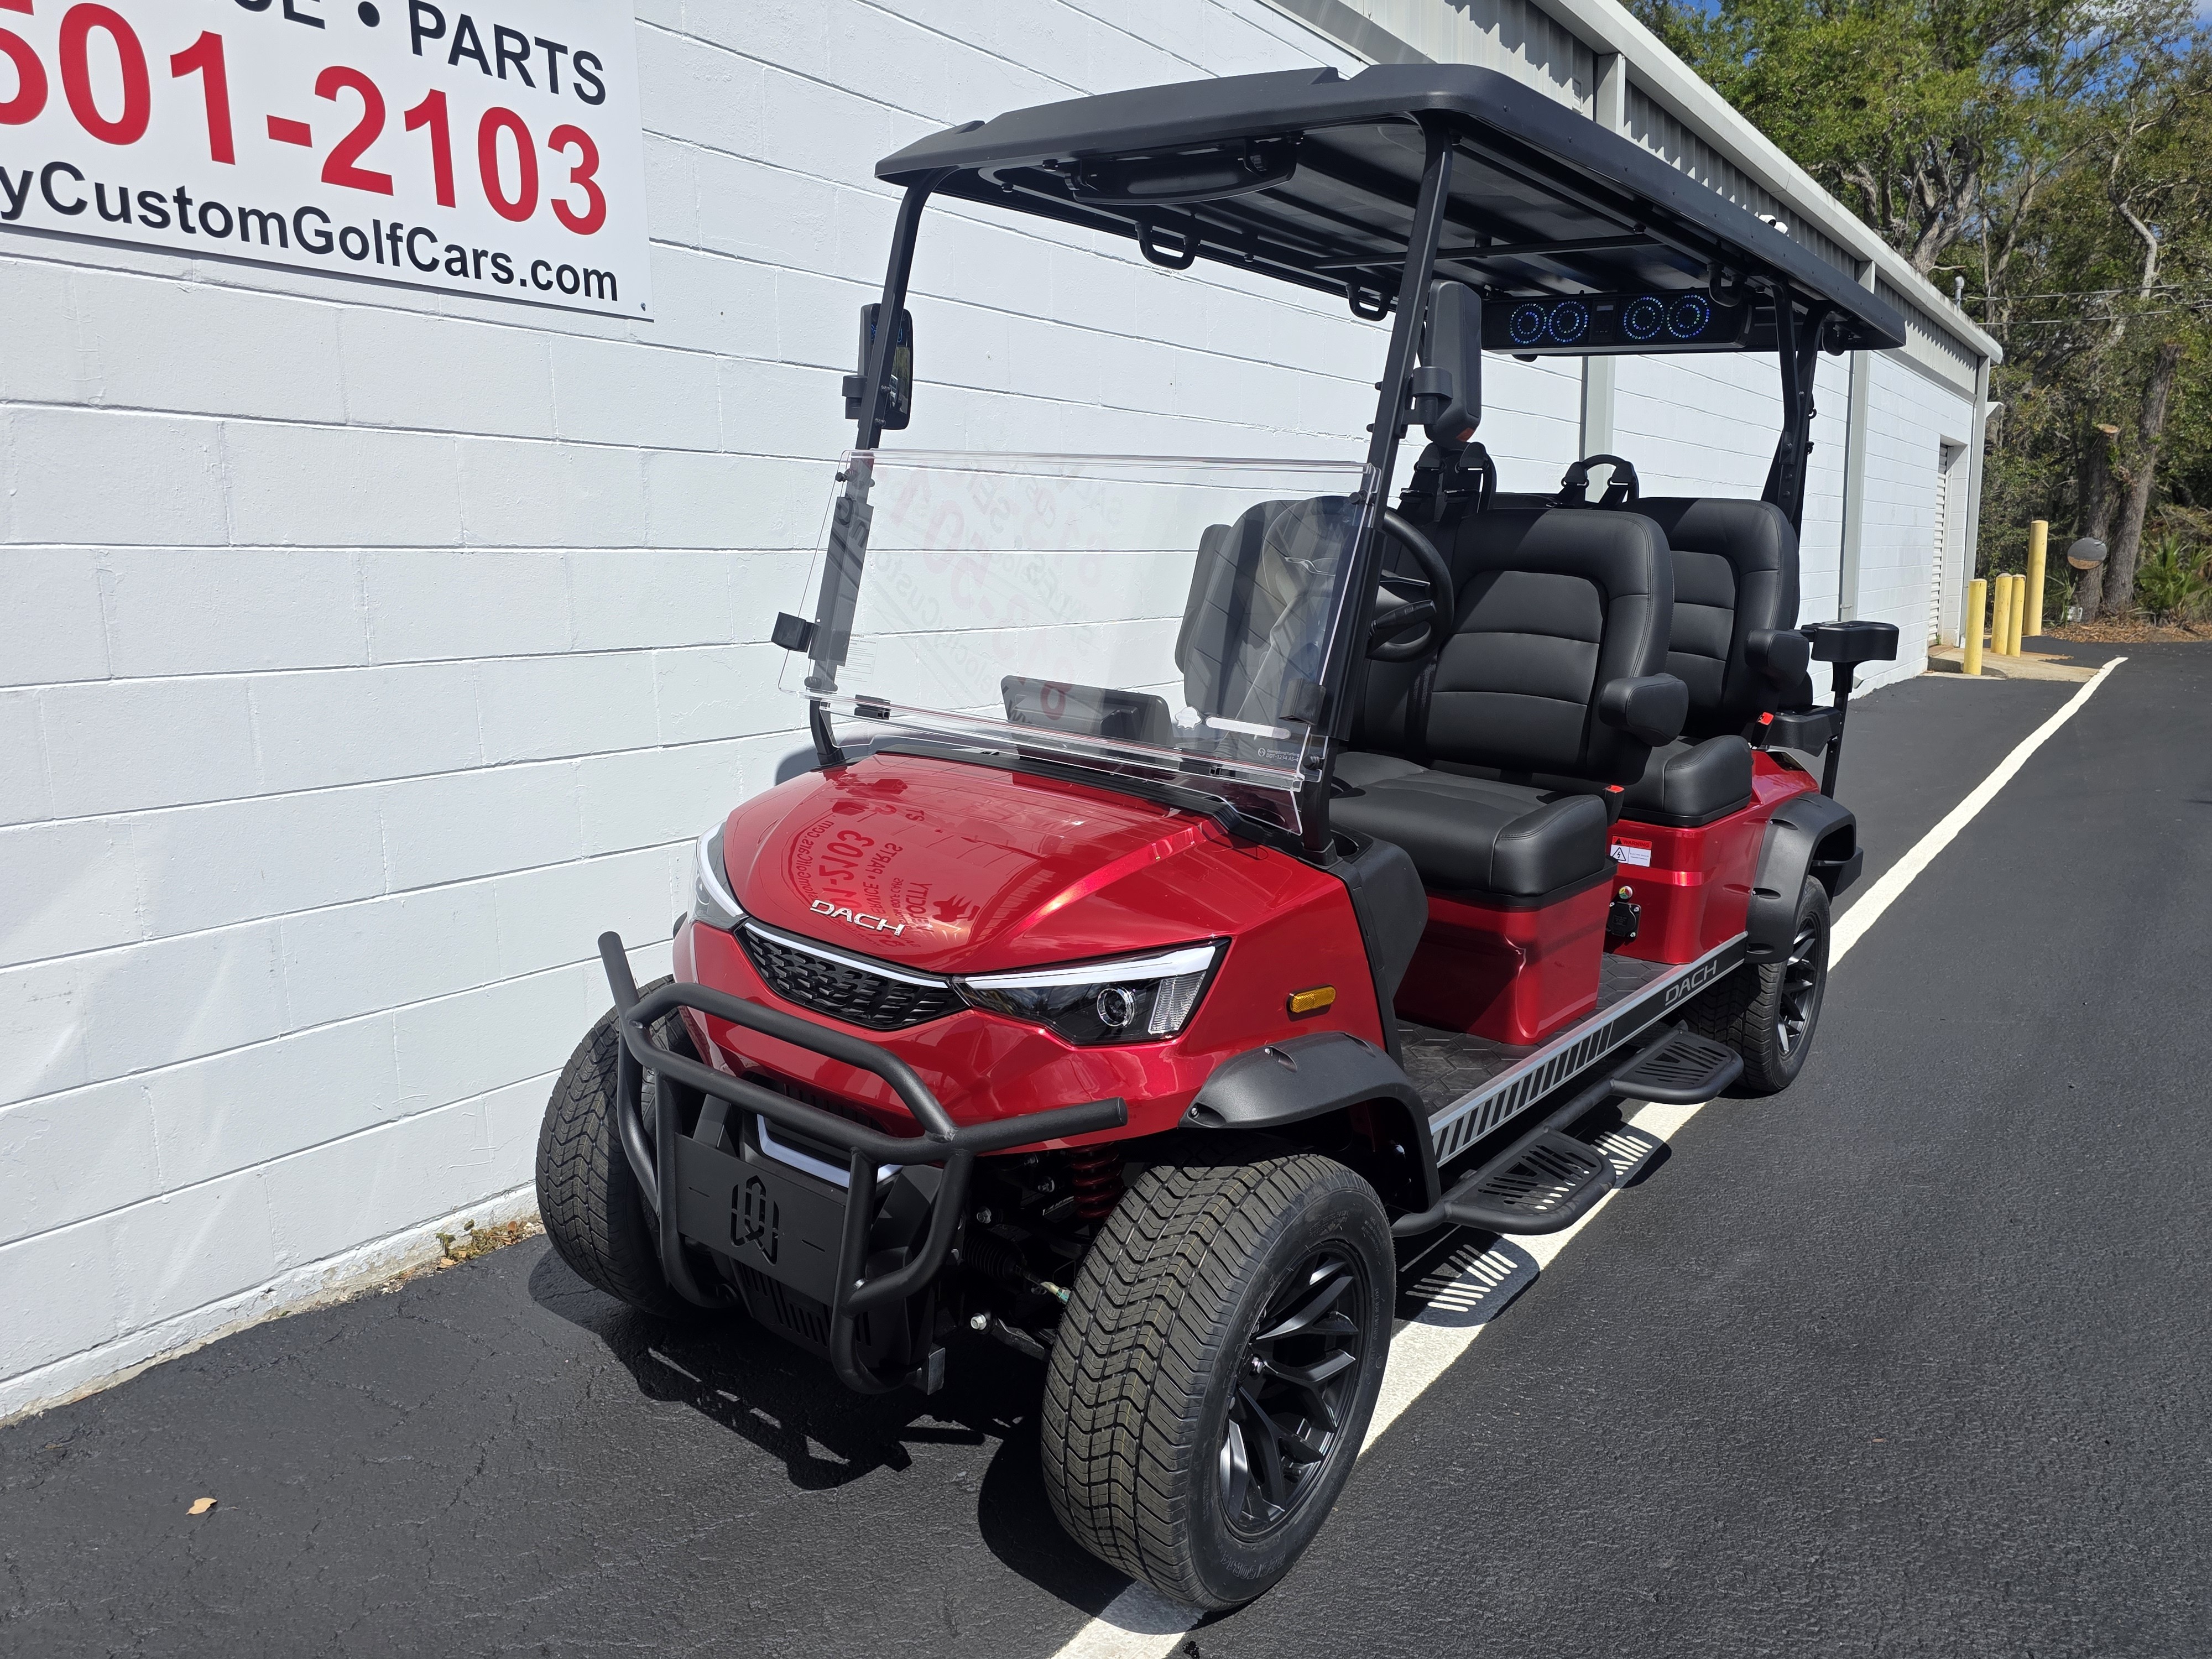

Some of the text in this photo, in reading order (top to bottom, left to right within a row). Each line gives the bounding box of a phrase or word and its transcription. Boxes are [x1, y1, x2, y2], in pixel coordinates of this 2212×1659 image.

[408, 0, 606, 106] PARTS
[1623, 839, 1650, 848] WARNING
[810, 899, 905, 937] DACH
[1665, 959, 1717, 1006] DACH
